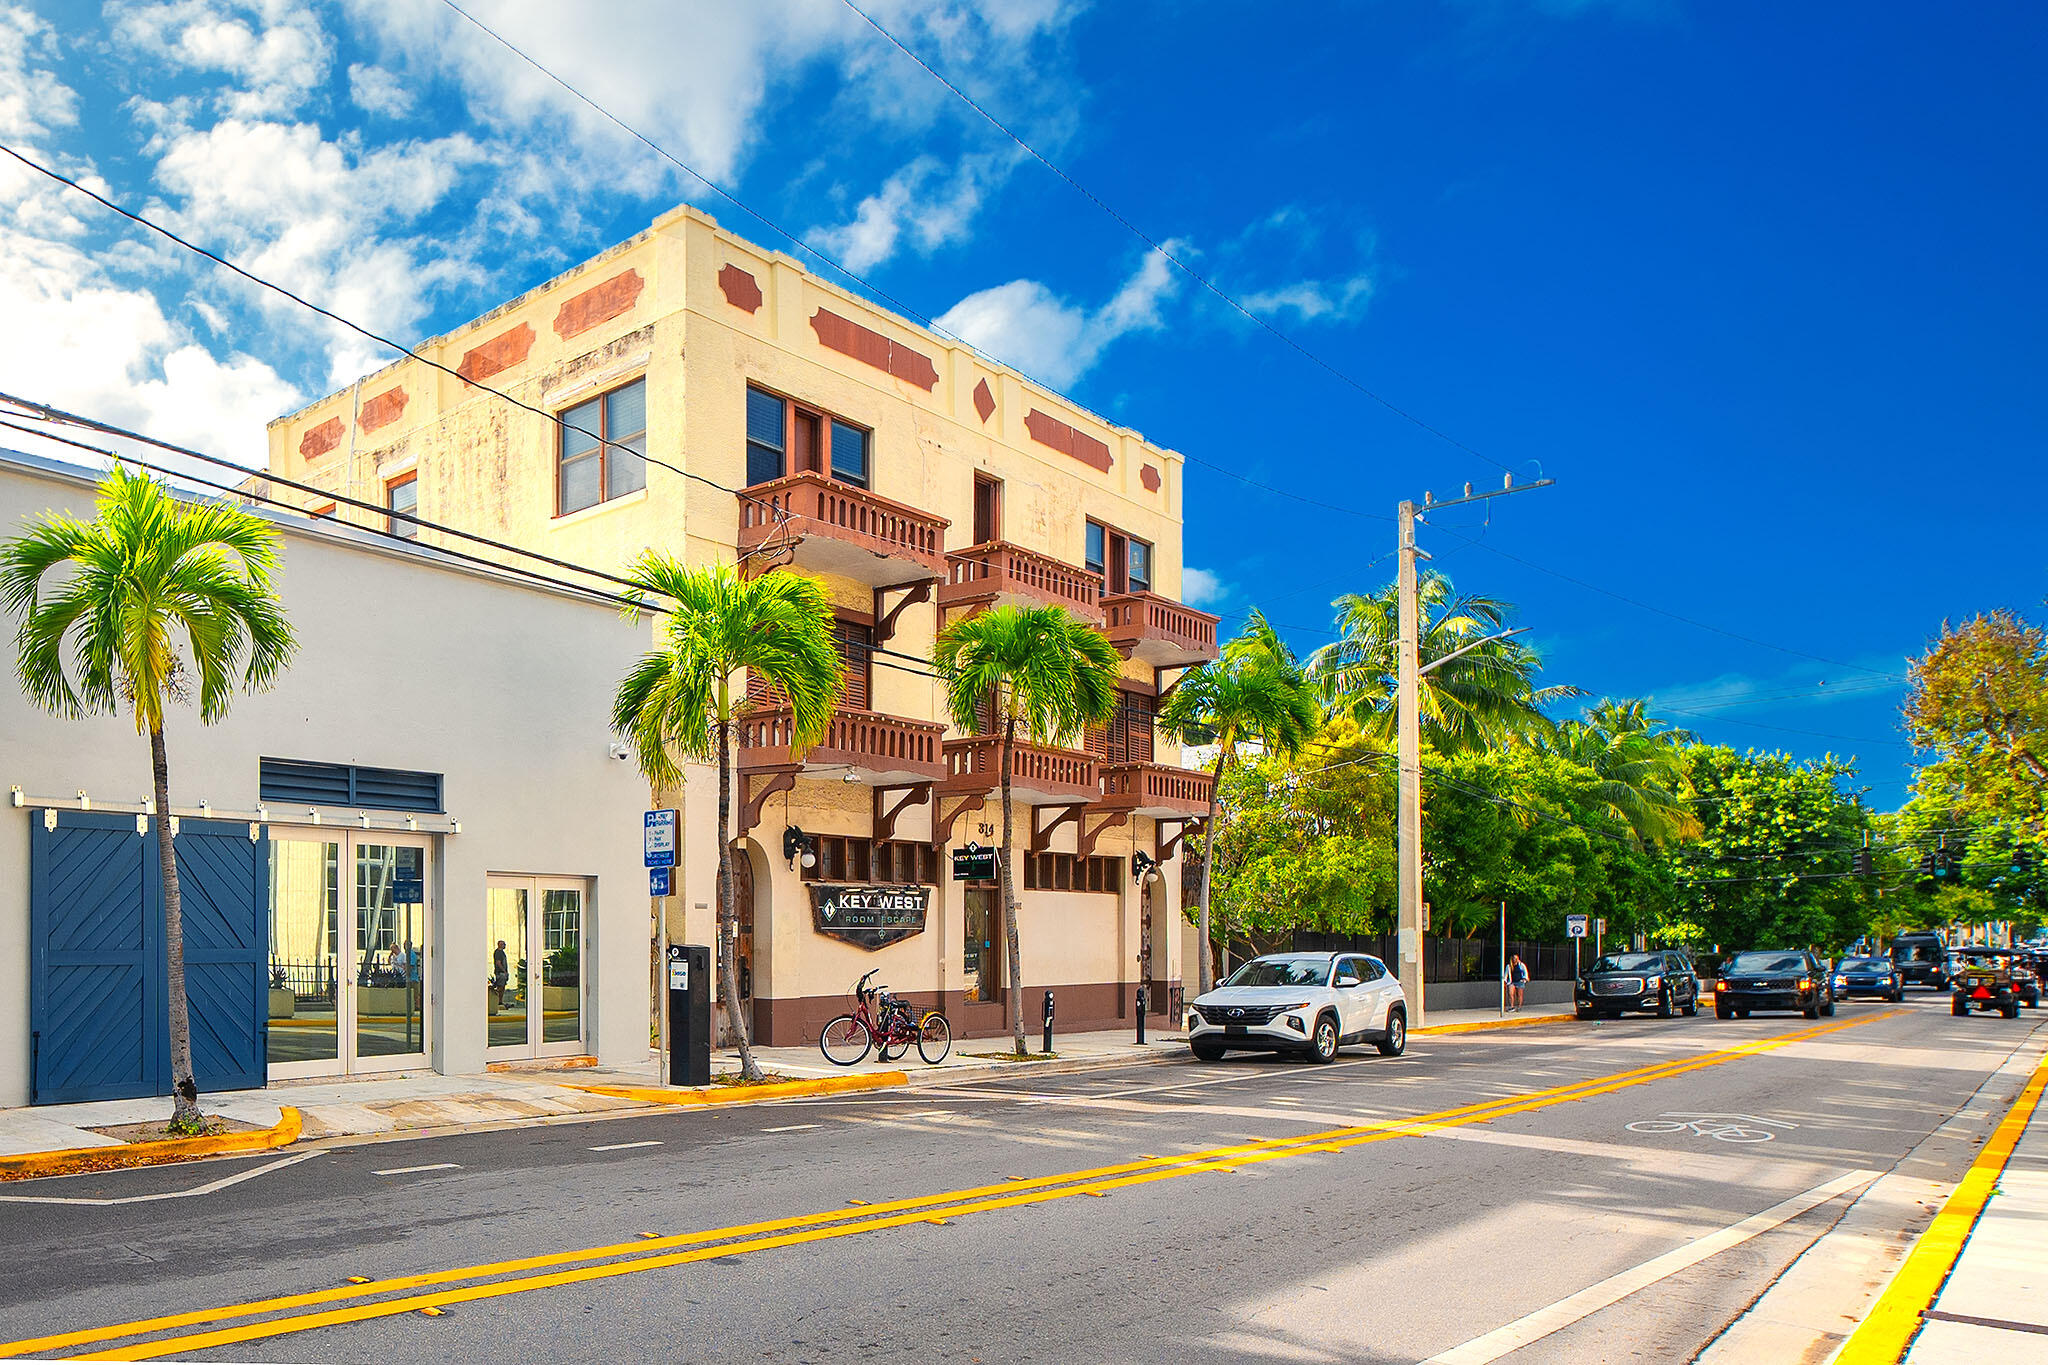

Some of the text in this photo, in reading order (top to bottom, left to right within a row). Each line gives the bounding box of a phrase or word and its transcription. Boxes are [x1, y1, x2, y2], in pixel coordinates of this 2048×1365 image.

[970, 853, 993, 861] WEST
[839, 894, 923, 909] KEY WEST
[845, 915, 917, 924] ROOM ESCAPE
